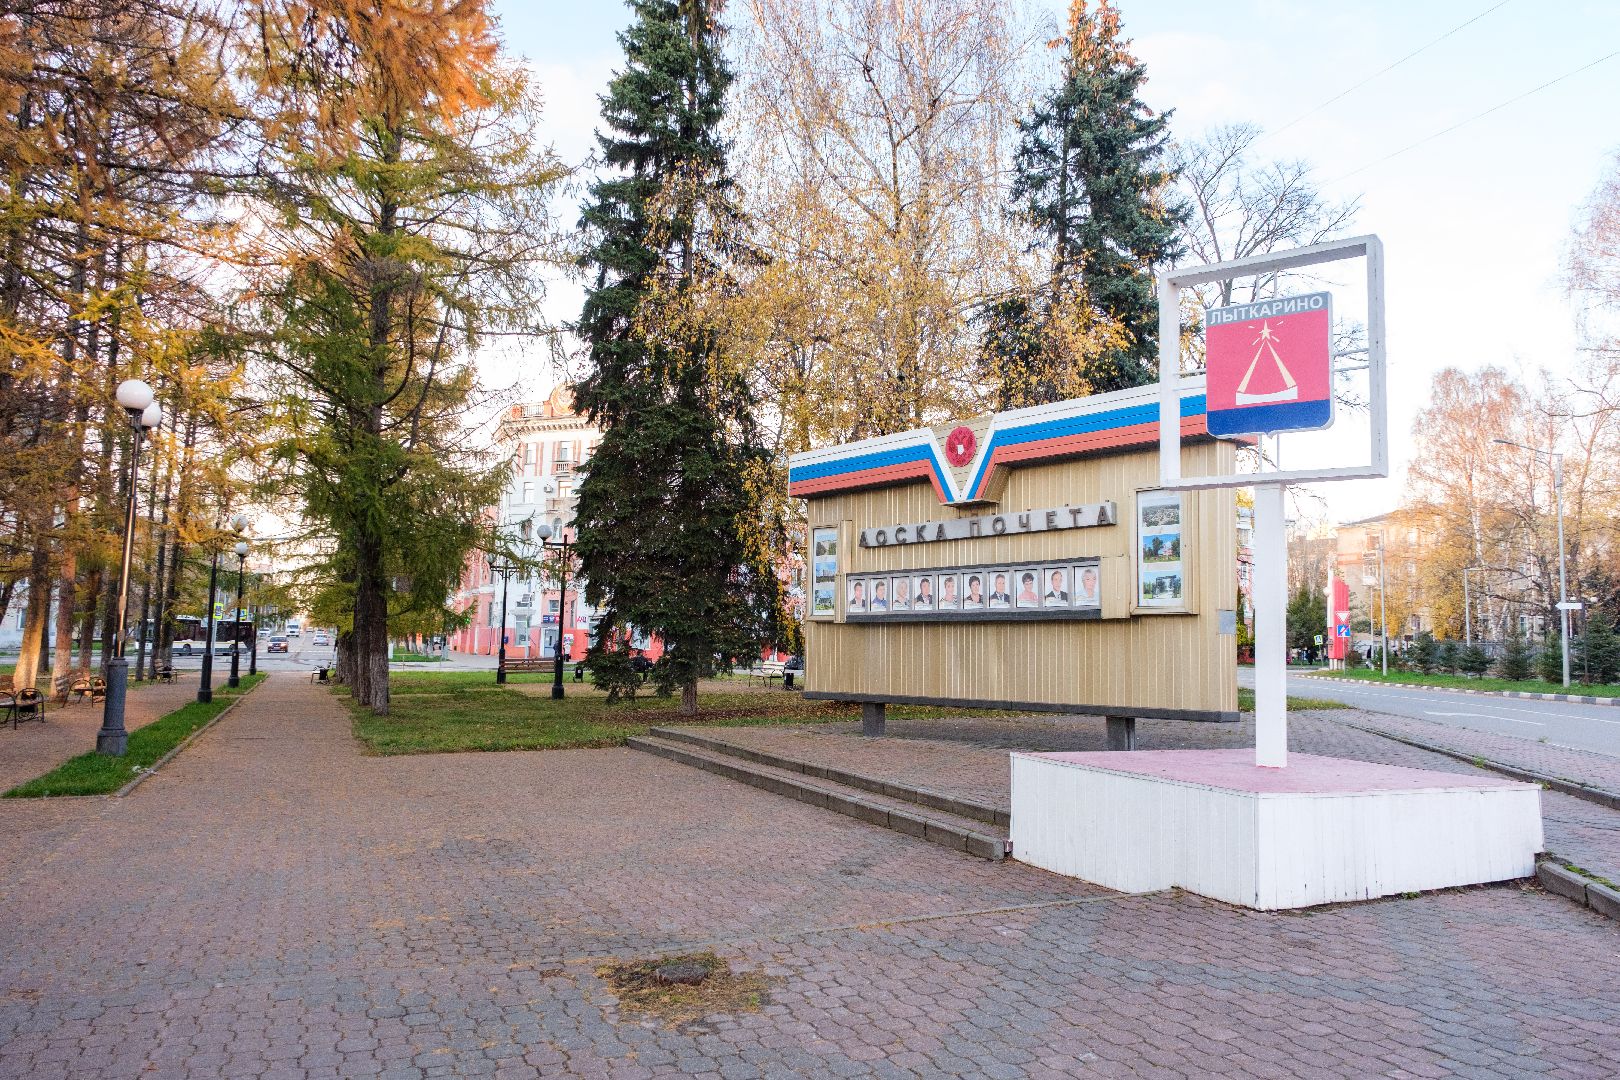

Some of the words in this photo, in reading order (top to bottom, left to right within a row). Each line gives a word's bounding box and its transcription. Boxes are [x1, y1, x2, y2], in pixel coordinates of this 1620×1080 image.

[1210, 295, 1323, 324] ЛЫТКАРИНО
[859, 523, 948, 548] ДОСКА
[969, 505, 1112, 538] ПОЧЕТА
